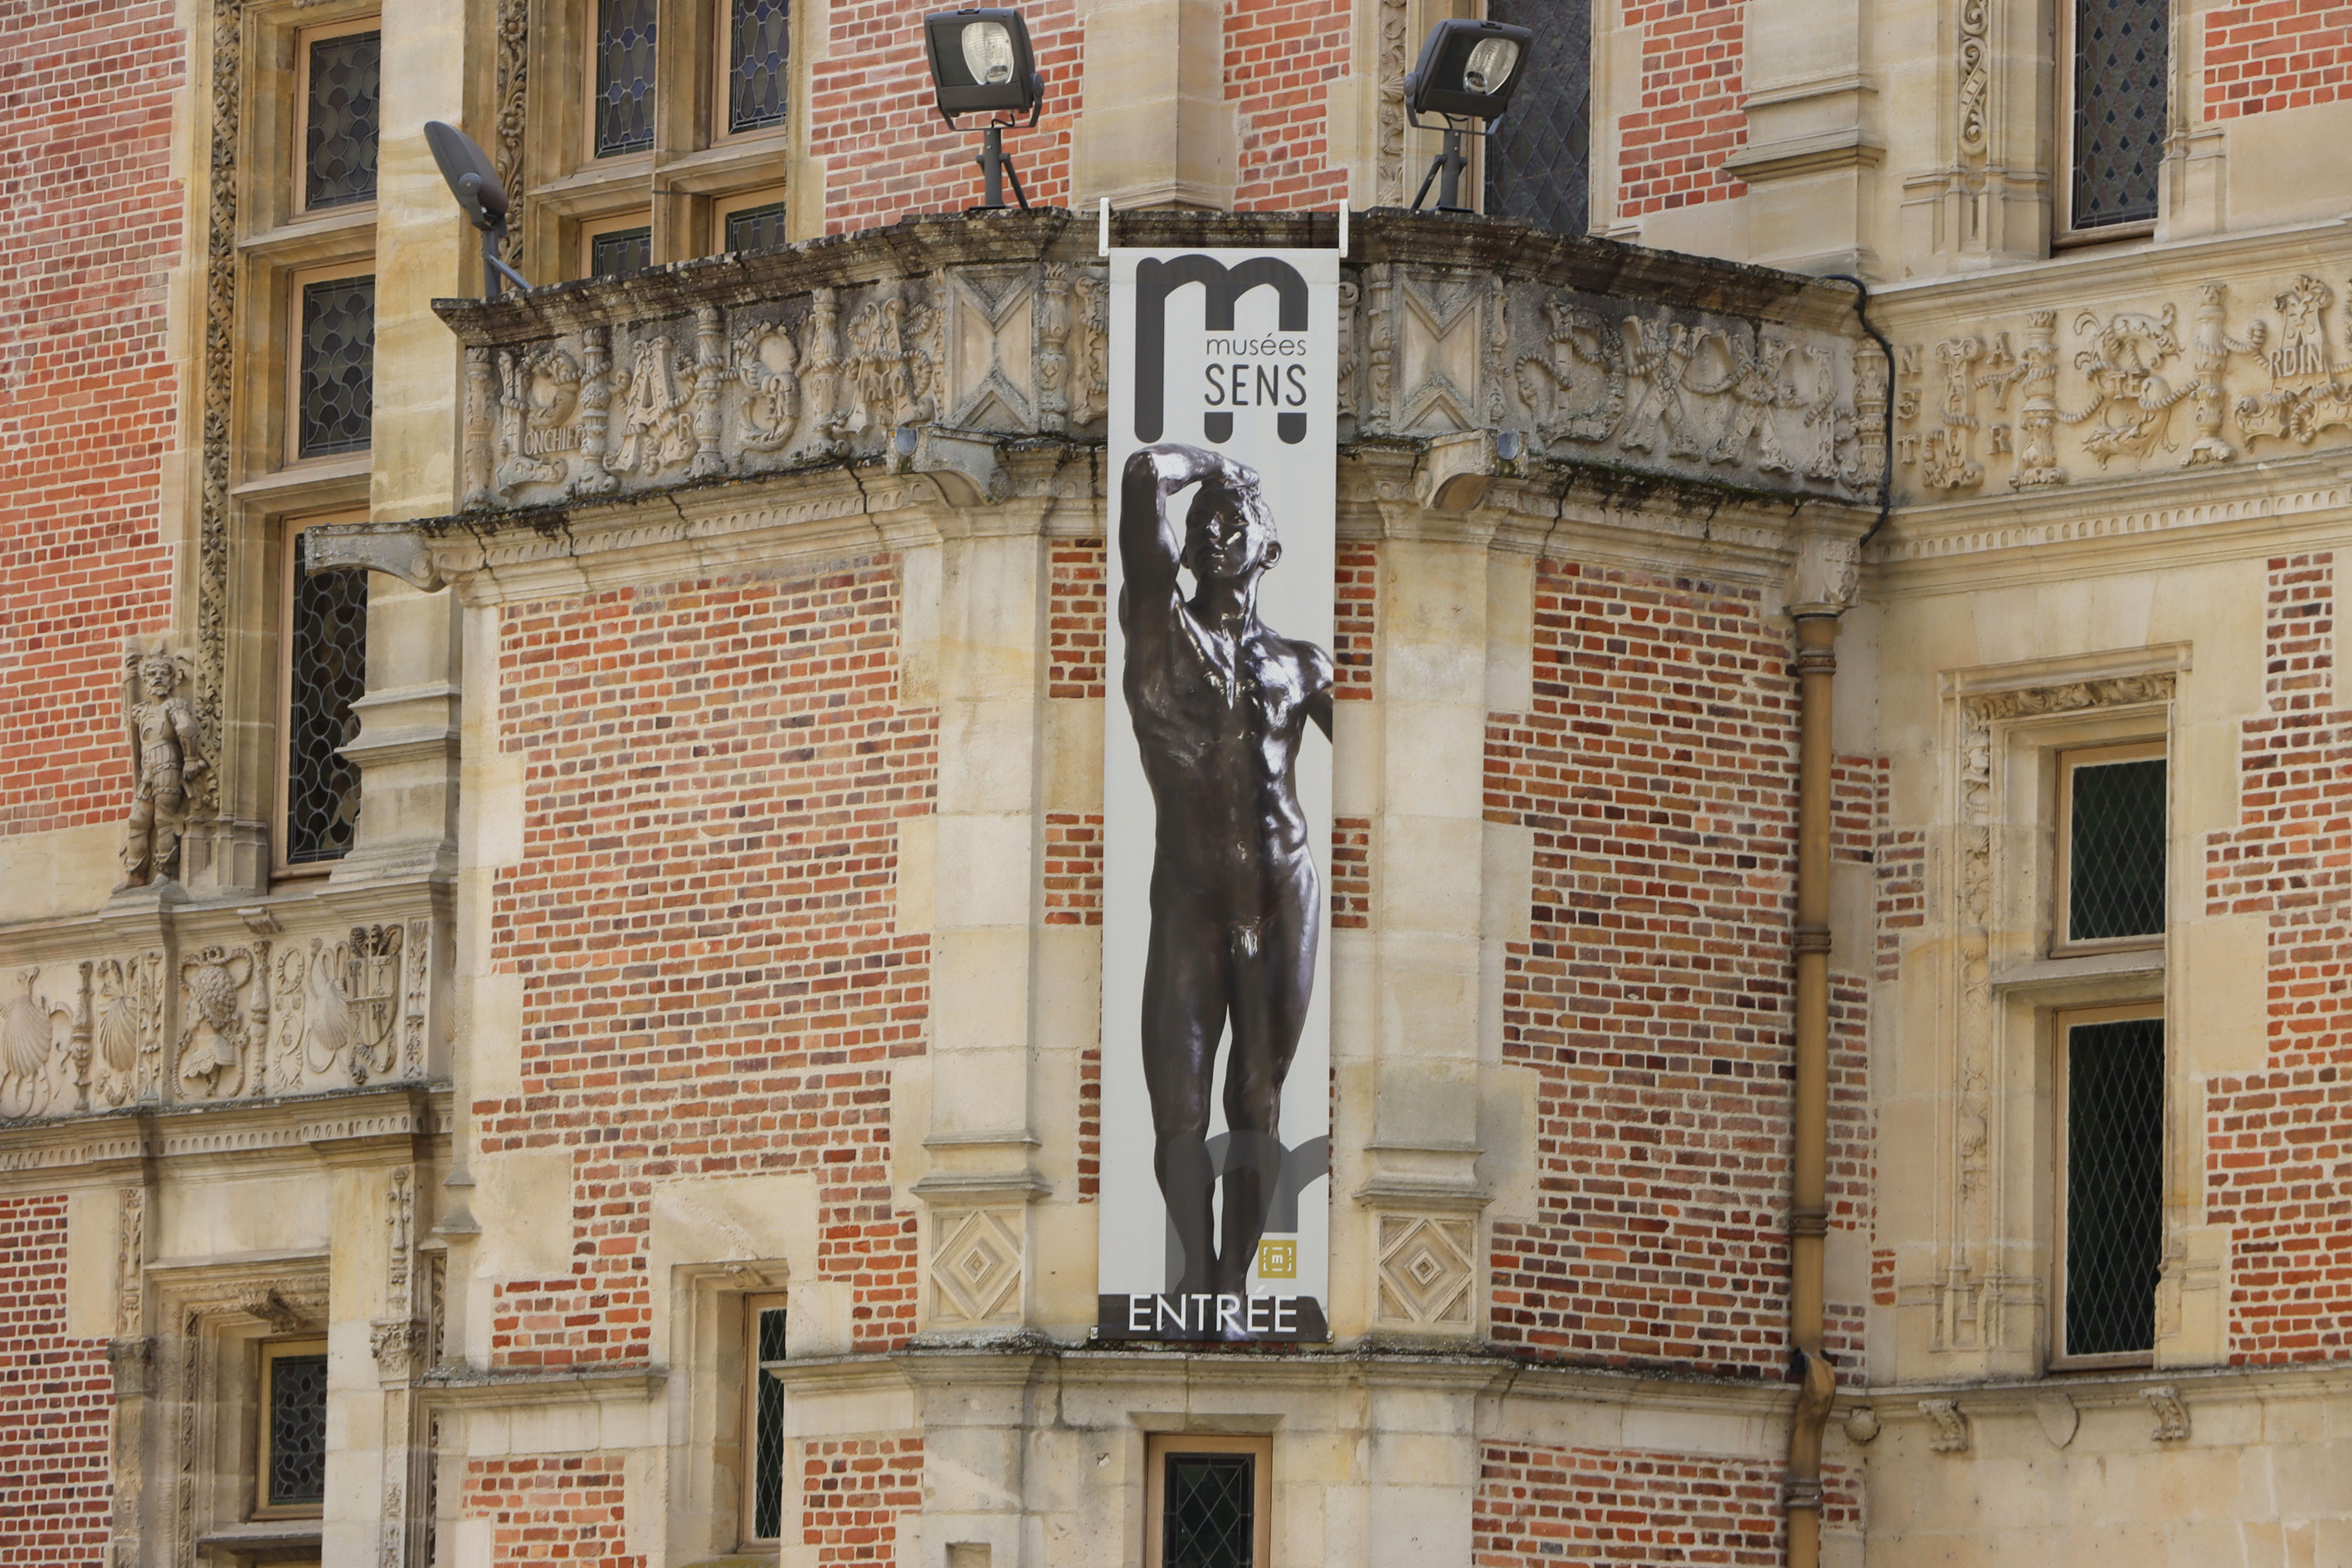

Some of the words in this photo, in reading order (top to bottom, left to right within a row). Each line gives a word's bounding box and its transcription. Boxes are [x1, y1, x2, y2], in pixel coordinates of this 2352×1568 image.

[1206, 333, 1307, 356] musées
[1205, 363, 1307, 407] SENS
[1128, 1285, 1297, 1333] ENTRÉE
